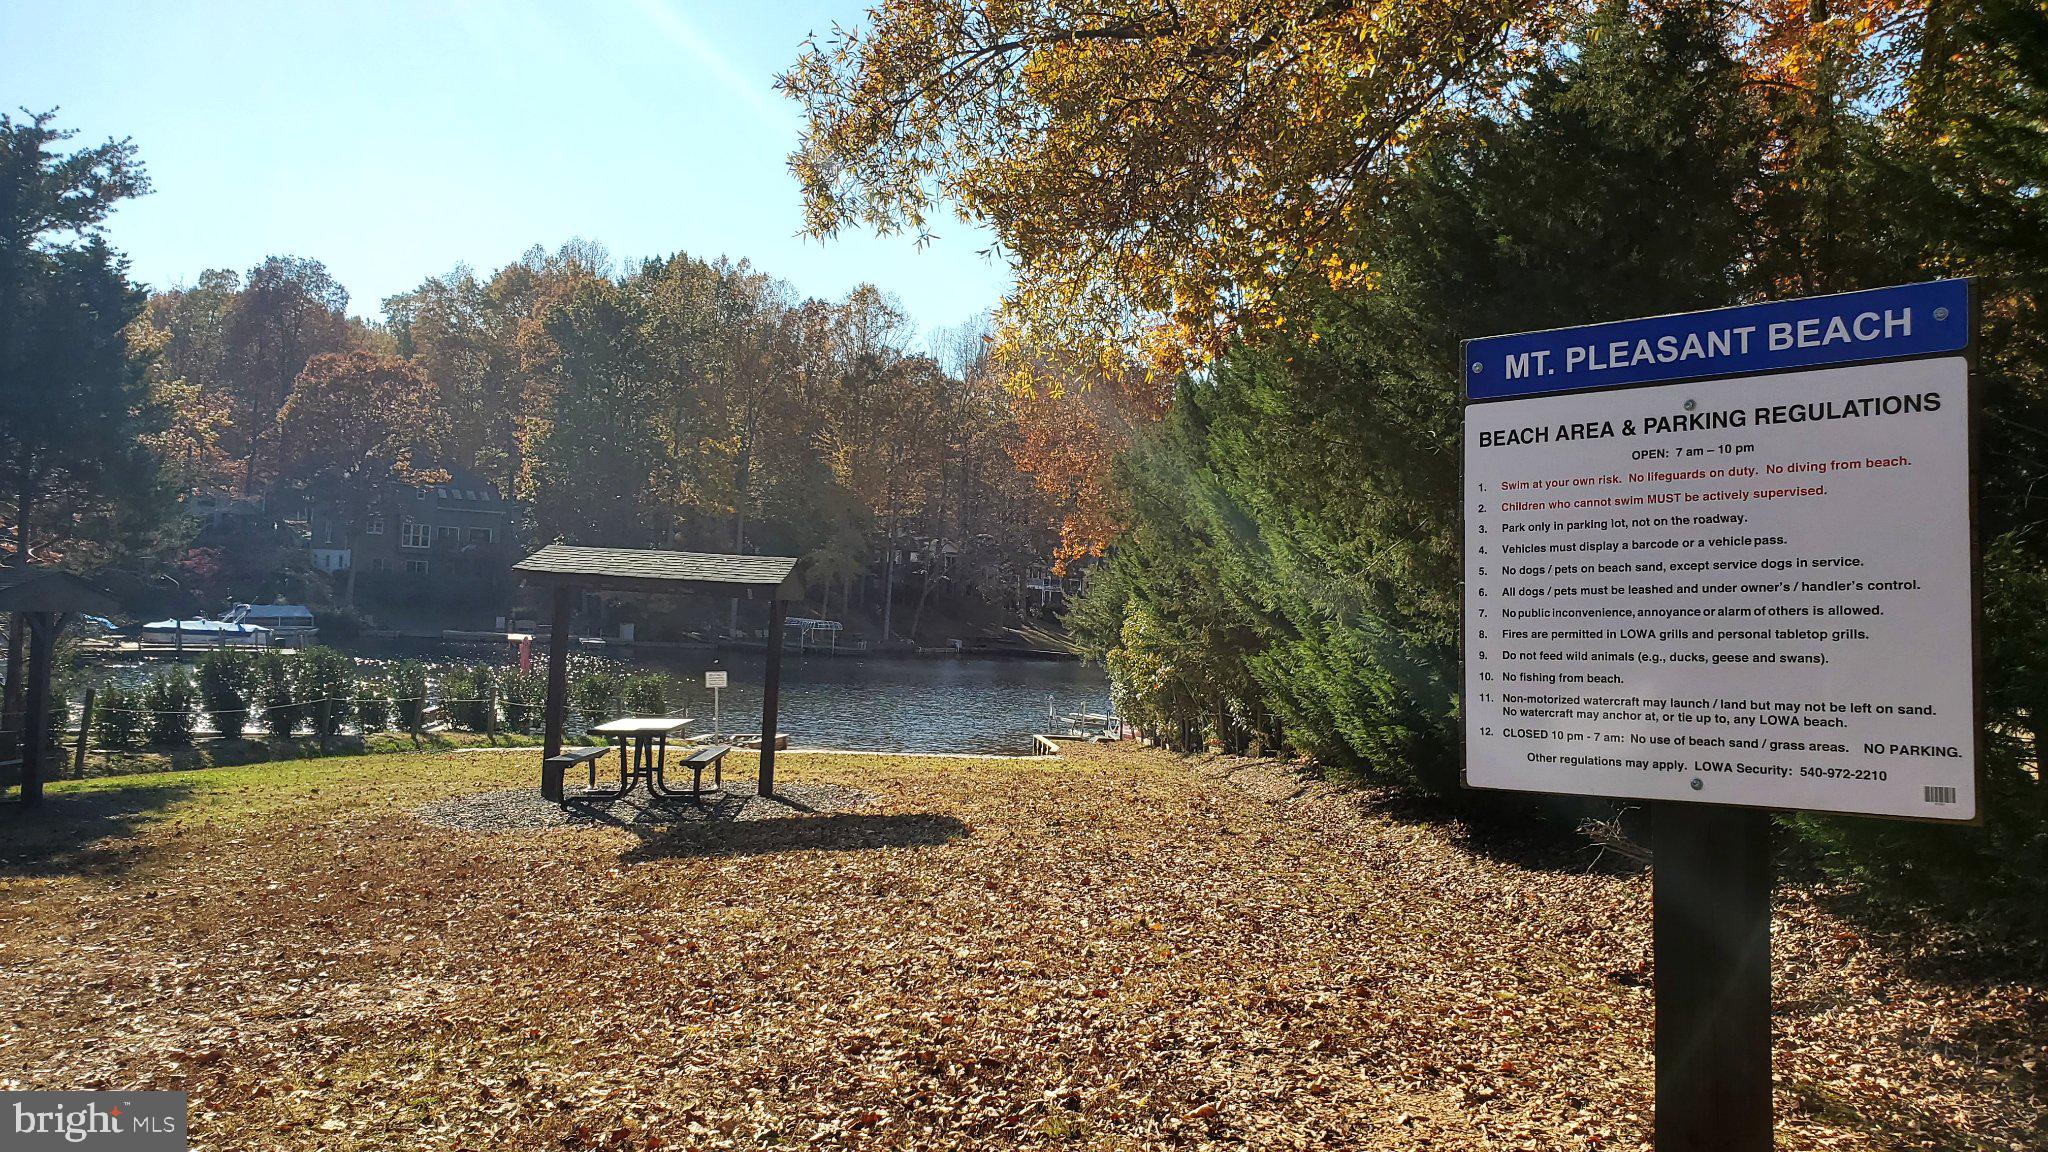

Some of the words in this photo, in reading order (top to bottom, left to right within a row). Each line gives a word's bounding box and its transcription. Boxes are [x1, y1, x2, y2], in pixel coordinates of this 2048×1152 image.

[1506, 350, 1554, 379] MT.
[1567, 326, 1756, 372] PLEASANT
[1769, 307, 1911, 351] BEACH
[1479, 426, 1548, 448] BEACH
[1555, 421, 1615, 442] AREA
[1622, 419, 1637, 436] &
[1644, 409, 1746, 434] PARKING
[1755, 392, 1941, 425] REGULATIONS
[1632, 448, 1669, 460] OPEN:
[1675, 447, 1683, 457] 7
[1686, 448, 1704, 456] am
[1718, 444, 1732, 454] 10
[1735, 444, 1754, 456] pm
[1501, 480, 1529, 490] Swim
[1532, 480, 1543, 489] at
[1545, 479, 1570, 490] your
[1572, 478, 1595, 486] own
[1598, 474, 1622, 484] risk.
[1629, 473, 1644, 483] No
[1648, 469, 1706, 483] lifeguards
[1709, 470, 1724, 478] on
[1728, 466, 1759, 478] duty.
[1766, 464, 1783, 474] No
[1787, 462, 1826, 473] diving
[1830, 460, 1861, 470] from
[1866, 456, 1912, 468] beach.
[1501, 501, 1545, 512] Children
[1548, 499, 1571, 509] who
[1574, 497, 1611, 508] cannot
[1614, 496, 1643, 506] swim
[1647, 493, 1681, 504] MUST
[1685, 492, 1699, 502] be
[1703, 489, 1749, 501] actively
[1753, 485, 1827, 500] supervised.
[1502, 523, 1526, 533] Park
[1528, 522, 1551, 533] only
[1554, 521, 1564, 530] in
[1567, 519, 1608, 532] parking
[1611, 518, 1628, 529] lot,
[1632, 517, 1650, 527] not
[1653, 518, 1668, 526] on
[1670, 516, 1690, 525] the
[1693, 514, 1748, 525] roadway.
[1502, 544, 1547, 554] Vehicles
[1549, 543, 1576, 552] must
[1579, 541, 1619, 553] display
[1632, 539, 1679, 549] barcode
[1682, 540, 1695, 548] or
[1708, 536, 1752, 547] vehicle
[1754, 537, 1787, 548] pass.
[1502, 566, 1516, 575] No
[1519, 565, 1546, 577] dogs
[1555, 565, 1578, 576] pets
[1598, 562, 1632, 573] beach
[1635, 562, 1666, 573] sand,
[1669, 561, 1710, 573] except
[1713, 559, 1757, 570] service
[1761, 558, 1792, 571] dogs
[1796, 557, 1808, 568] in
[1812, 556, 1864, 567] service.
[1502, 587, 1516, 596] All
[1518, 587, 1545, 598] dogs
[1554, 586, 1577, 598] pets
[1580, 586, 1608, 595] must
[1611, 585, 1625, 595] be
[1628, 584, 1673, 594] leashed
[1676, 583, 1698, 594] and
[1702, 583, 1737, 593] under
[1867, 579, 1921, 591] control.
[1502, 608, 1516, 618] No
[1518, 608, 1550, 620] public
[1552, 607, 1635, 619] inconvenience,
[1637, 609, 1701, 619] annoyance
[1703, 608, 1716, 616] or
[1717, 606, 1751, 616] alarm
[1754, 606, 1766, 616] of
[1768, 606, 1809, 616] others
[1813, 605, 1824, 616] is
[1828, 605, 1884, 615] allowed.
[1502, 629, 1528, 639] Fires
[1531, 631, 1548, 639] are
[1551, 629, 1603, 641] permitted
[1607, 629, 1617, 639] in
[1620, 629, 1656, 639] LOWA
[1659, 629, 1689, 641] grills
[1692, 629, 1714, 639] and
[1718, 629, 1771, 641] personal
[1774, 629, 1828, 642] tabletop
[1832, 629, 1869, 642] grills.
[1502, 650, 1516, 660] Do
[1520, 651, 1537, 660] not
[1539, 651, 1563, 660] feed
[1565, 651, 1588, 661] wild
[1591, 651, 1635, 661] animals
[1669, 652, 1708, 664] ducks,
[1712, 654, 1749, 665] geese
[1752, 652, 1776, 663] and
[1779, 653, 1829, 666] swans).
[1502, 672, 1517, 681] No
[1519, 672, 1556, 684] fishing
[1558, 673, 1584, 683] from
[1587, 673, 1624, 684] beach.
[1503, 693, 1580, 705] Non-motorized
[1583, 697, 1639, 707] watercraft
[1643, 699, 1667, 710] may
[1670, 698, 1710, 709] launch
[1720, 699, 1746, 710] land
[1750, 700, 1771, 710] but
[1774, 703, 1801, 714] may
[1805, 702, 1826, 712] not
[1830, 702, 1846, 712] be
[1850, 702, 1872, 713] left
[1876, 705, 1893, 714] on
[1898, 705, 1936, 715] sand.
[1503, 706, 1517, 716] No
[1519, 708, 1573, 718] watercraft
[1577, 711, 1599, 721] may
[1602, 710, 1642, 720] anchor
[1645, 712, 1659, 723] at,
[1662, 714, 1675, 722] or
[1678, 712, 1693, 722] tie
[1696, 715, 1711, 725] up
[1714, 714, 1730, 726] to,
[1733, 716, 1756, 727] any
[1760, 714, 1800, 726] LOWA
[1804, 716, 1847, 728] beach.
[1503, 728, 1548, 739] CLOSED
[1551, 730, 1564, 740] 10
[1567, 733, 1583, 743] pm
[1594, 732, 1600, 741] 7
[1603, 735, 1624, 743] am:
[1630, 733, 1646, 744] No
[1650, 736, 1671, 745] use
[1674, 735, 1686, 746] of
[1689, 736, 1725, 747] beach
[1729, 739, 1758, 748] sand
[1769, 741, 1805, 752] grass
[1809, 743, 1849, 753] areas.
[1864, 743, 1885, 754] NO
[1889, 744, 1962, 758] PARKING.
[1527, 752, 1557, 763] Other
[1560, 755, 1622, 767] regulations
[1625, 760, 1649, 771] may
[1652, 760, 1687, 773] apply.
[1695, 761, 1733, 773] LOWA
[1736, 763, 1792, 778] Security:
[1800, 766, 1887, 781] 540-972-2210
